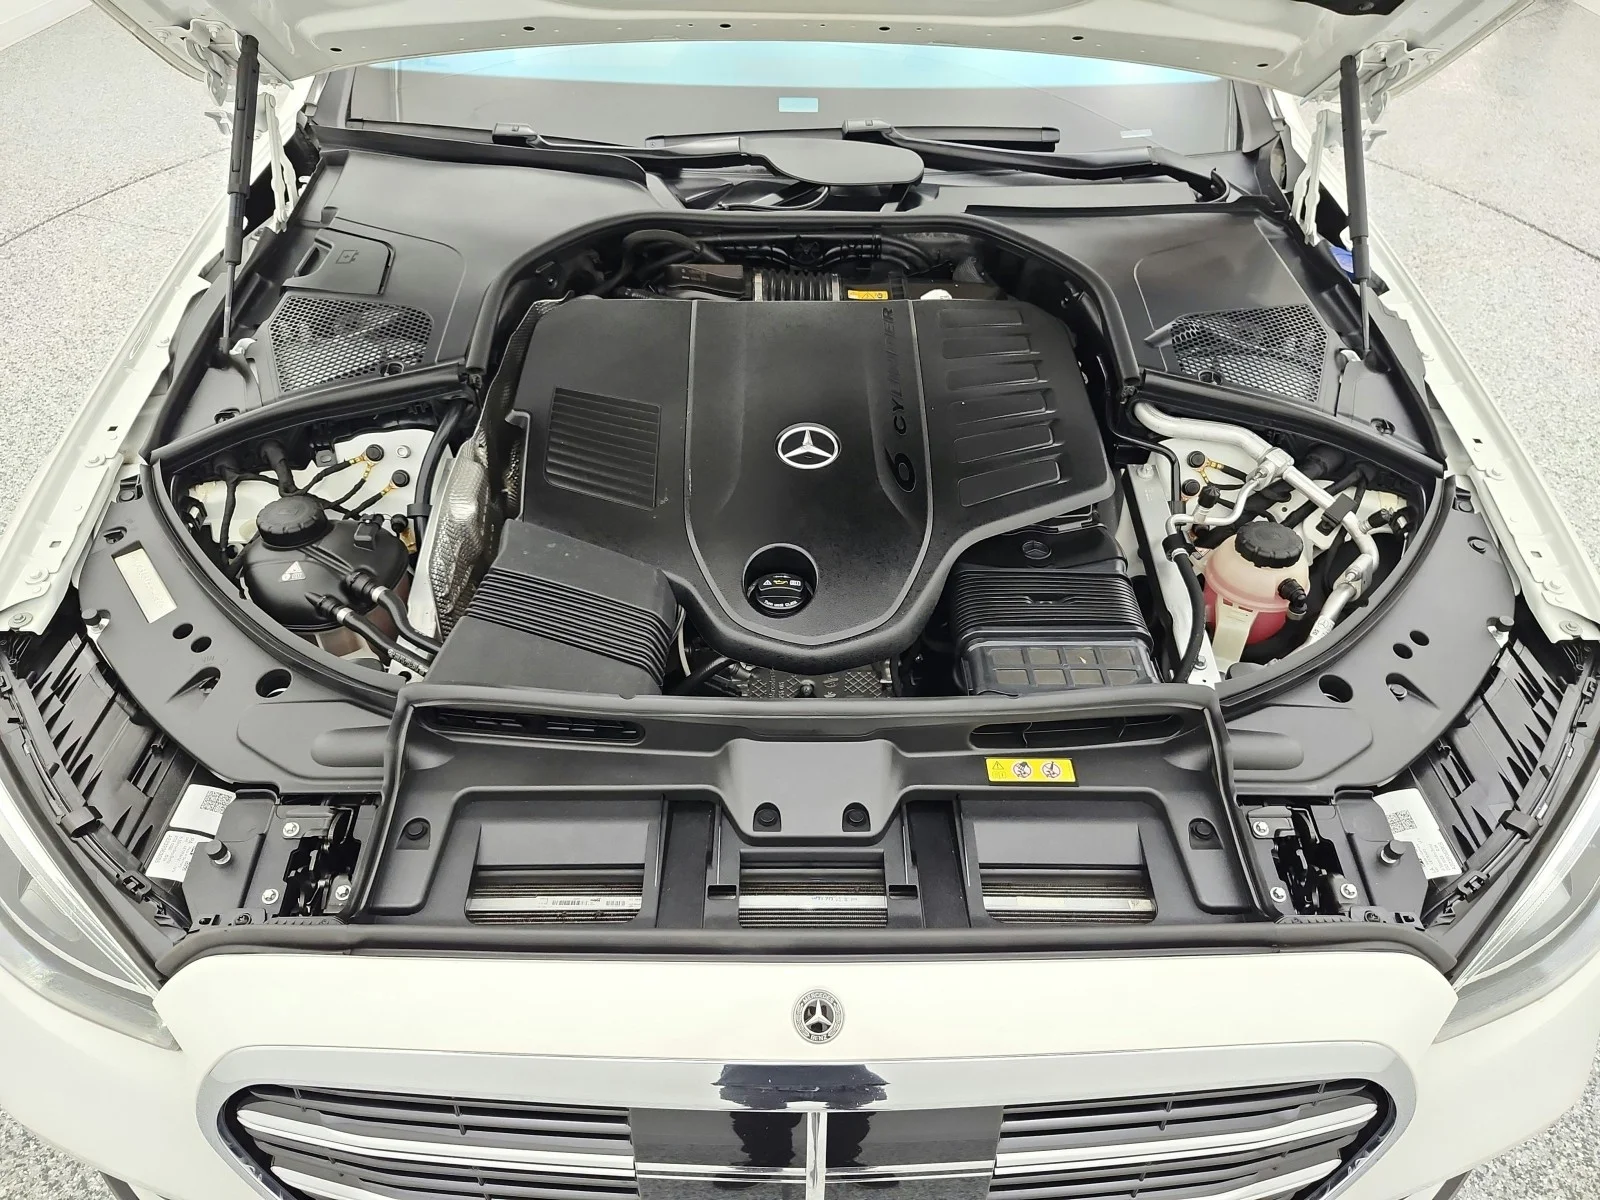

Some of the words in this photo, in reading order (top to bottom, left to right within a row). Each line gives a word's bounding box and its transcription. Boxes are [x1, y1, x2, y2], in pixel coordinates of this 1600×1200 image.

[881, 306, 908, 436] CYLINDER
[883, 445, 917, 493] 6
[803, 992, 835, 1003] MERCEDES
